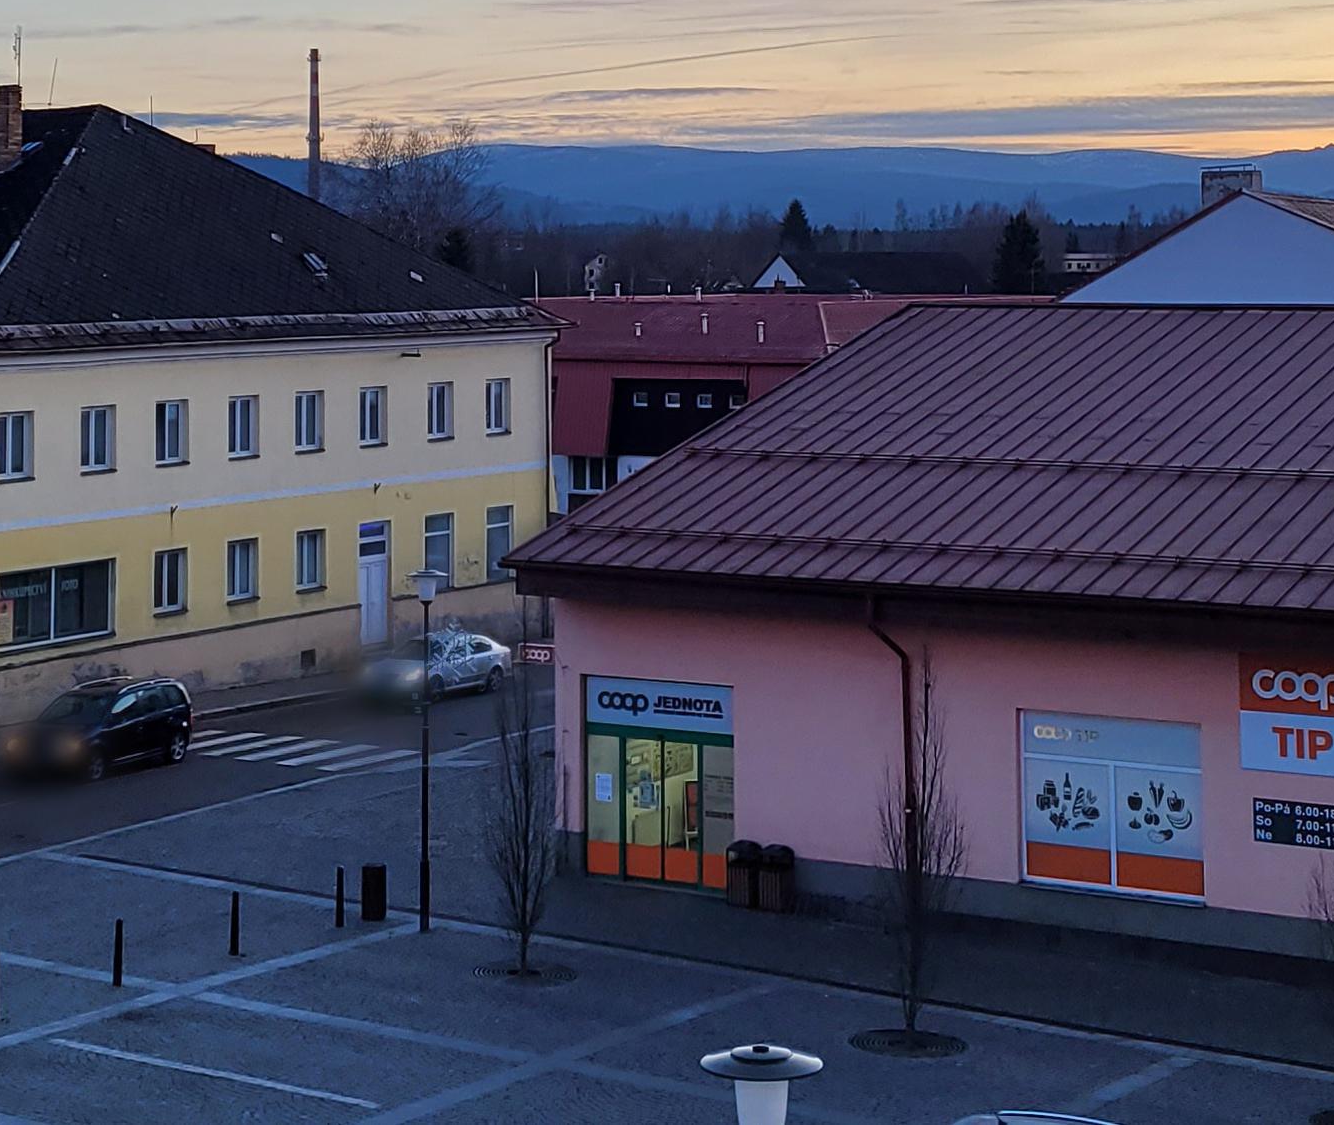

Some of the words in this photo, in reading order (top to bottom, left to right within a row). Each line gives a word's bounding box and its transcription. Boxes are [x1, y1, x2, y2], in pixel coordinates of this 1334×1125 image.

[598, 691, 649, 716] coop
[653, 696, 723, 714] JEDNOTA
[1272, 727, 1334, 760] TIP
[1255, 801, 1291, 815] Po-Pá
[1255, 815, 1273, 826] So
[1255, 829, 1273, 840] Ne
